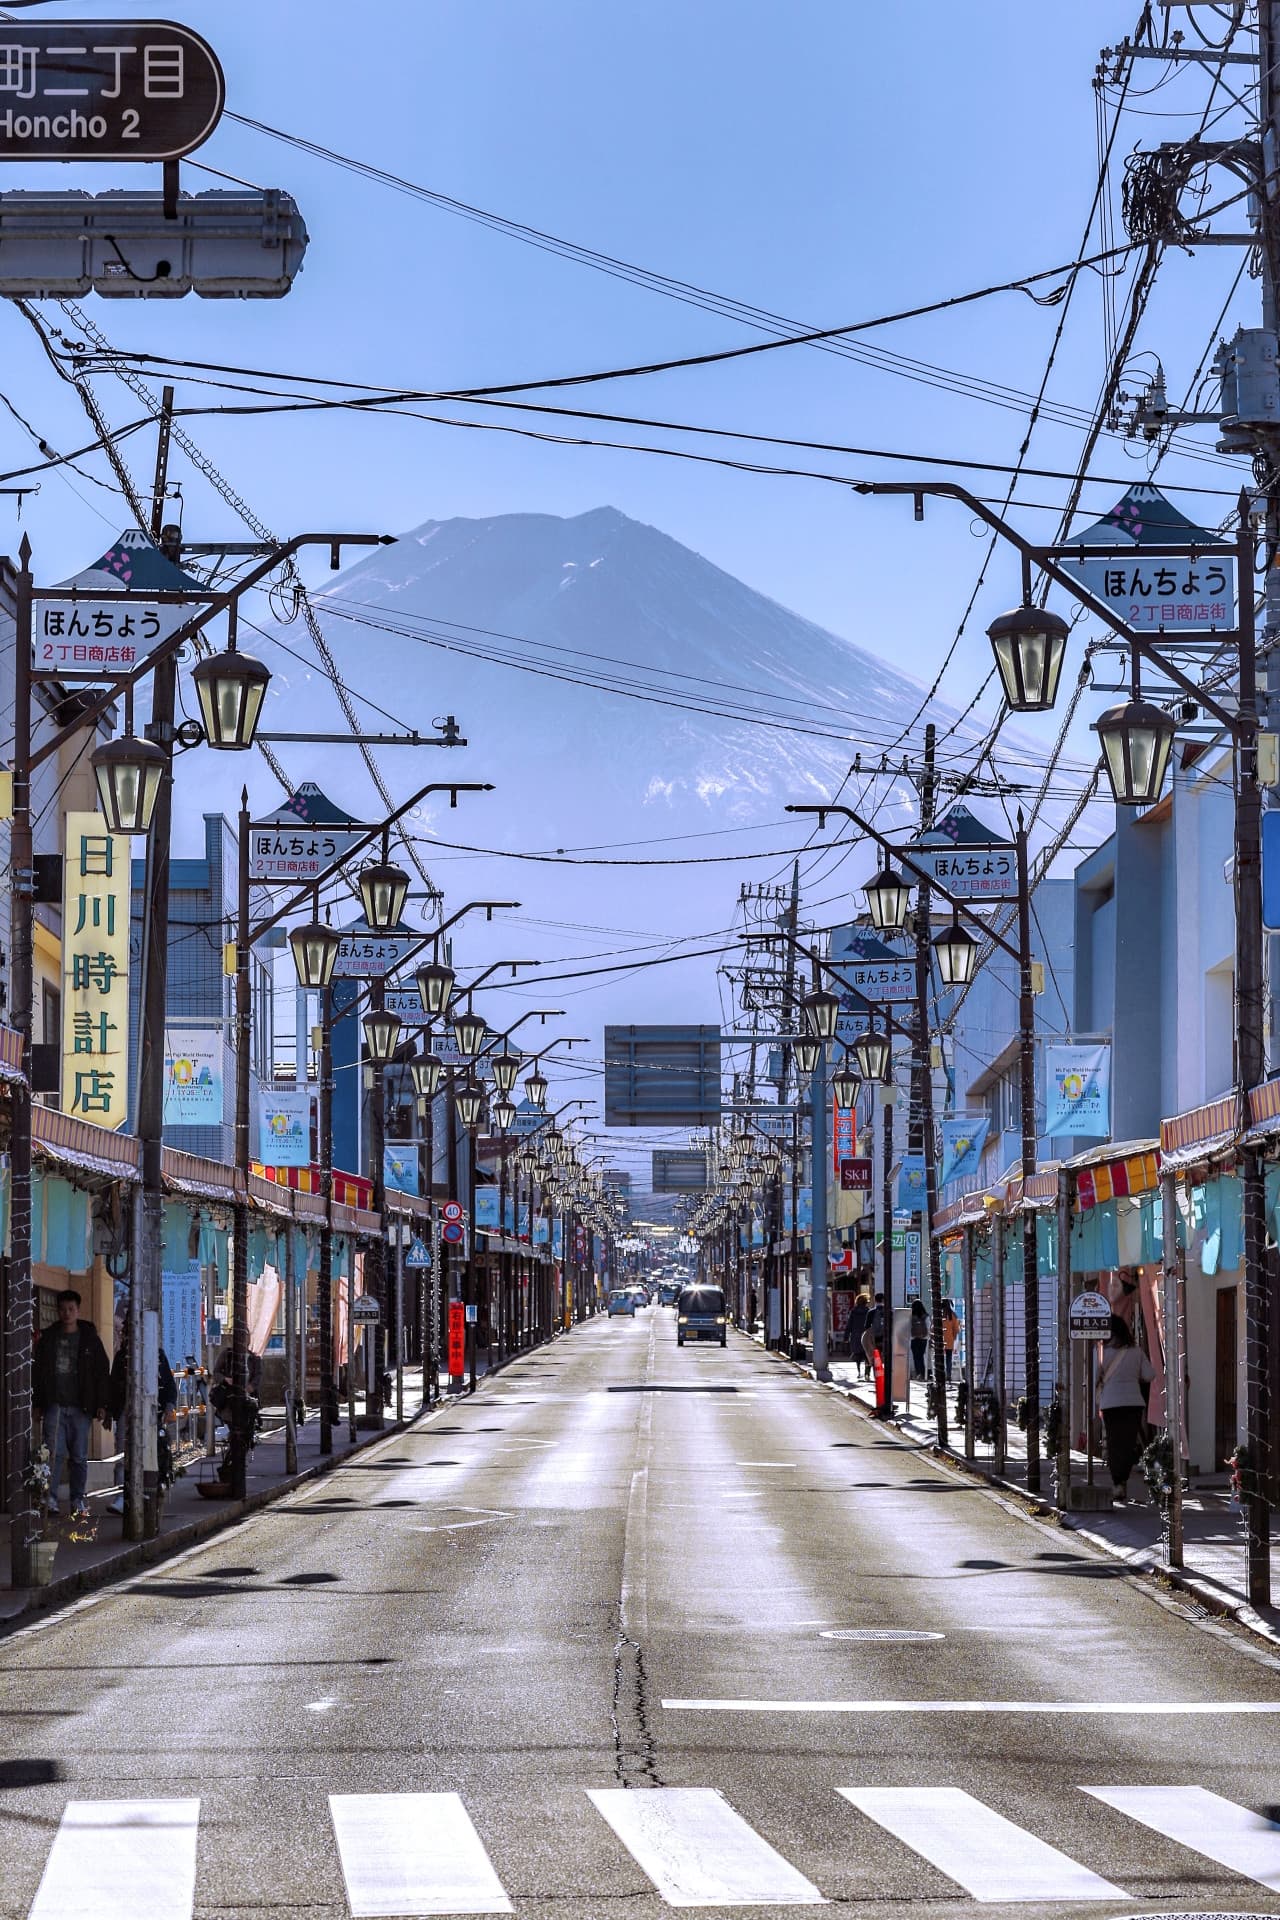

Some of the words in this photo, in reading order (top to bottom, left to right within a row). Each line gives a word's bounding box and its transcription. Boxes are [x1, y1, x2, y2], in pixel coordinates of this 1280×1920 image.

[0, 44, 184, 98] 町二丁目
[121, 109, 141, 138] 2
[1104, 566, 1227, 597] ほんちょう
[1129, 602, 1226, 622] 2丁目商店街
[43, 609, 161, 639] ほんちょう
[42, 643, 136, 663] 2丁目商店街
[256, 836, 337, 857] ほんちょう
[255, 859, 319, 872] 2丁目商店街
[934, 856, 1010, 876] ほんちょう
[951, 878, 1012, 892] 2丁目商店街
[337, 941, 400, 959] ほんちょう
[71, 834, 118, 1114] 日川時計店
[854, 967, 913, 985] ほんちょう
[447, 1206, 459, 1217] 40
